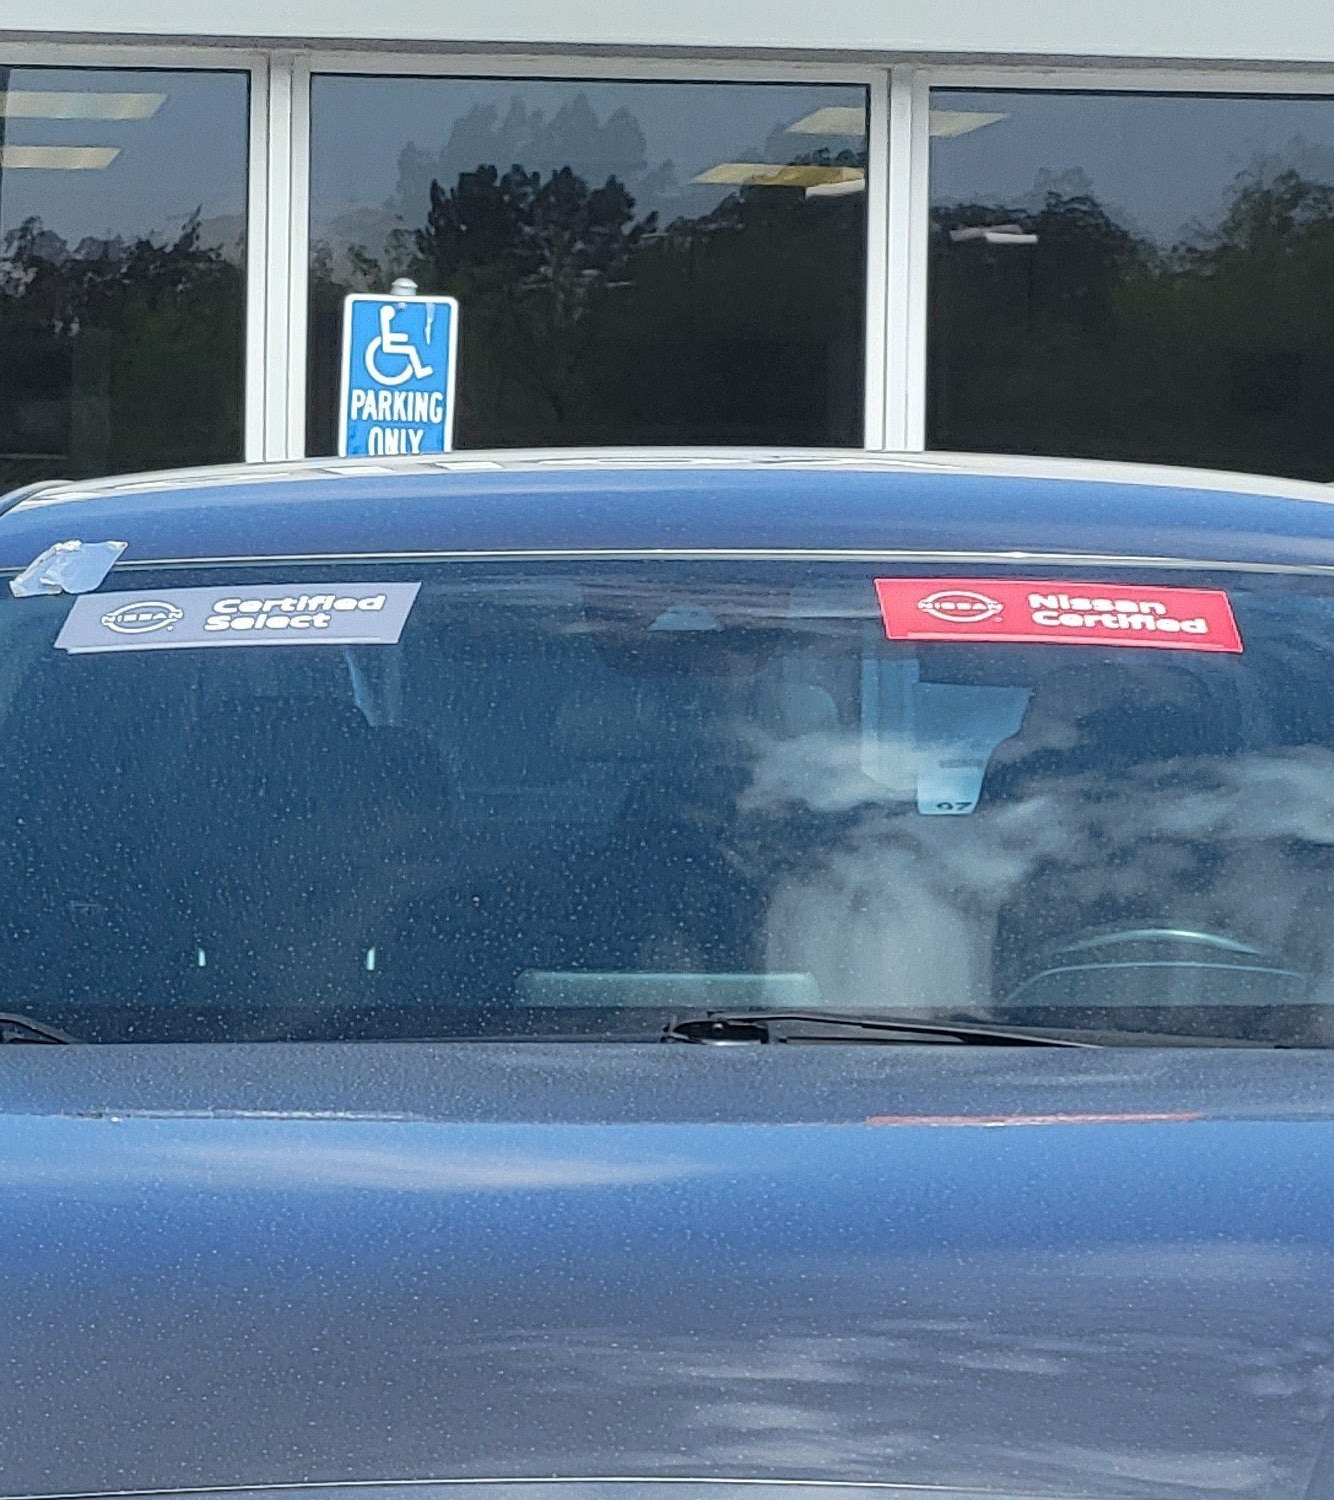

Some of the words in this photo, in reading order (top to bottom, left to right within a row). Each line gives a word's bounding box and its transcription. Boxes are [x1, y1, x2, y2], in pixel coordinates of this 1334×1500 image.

[350, 389, 444, 424] PARKING
[367, 425, 424, 456] ONLY
[213, 593, 387, 614] Certified
[1027, 592, 1167, 615] Nissan
[203, 611, 332, 632] Select
[1031, 609, 1209, 634] Certified
